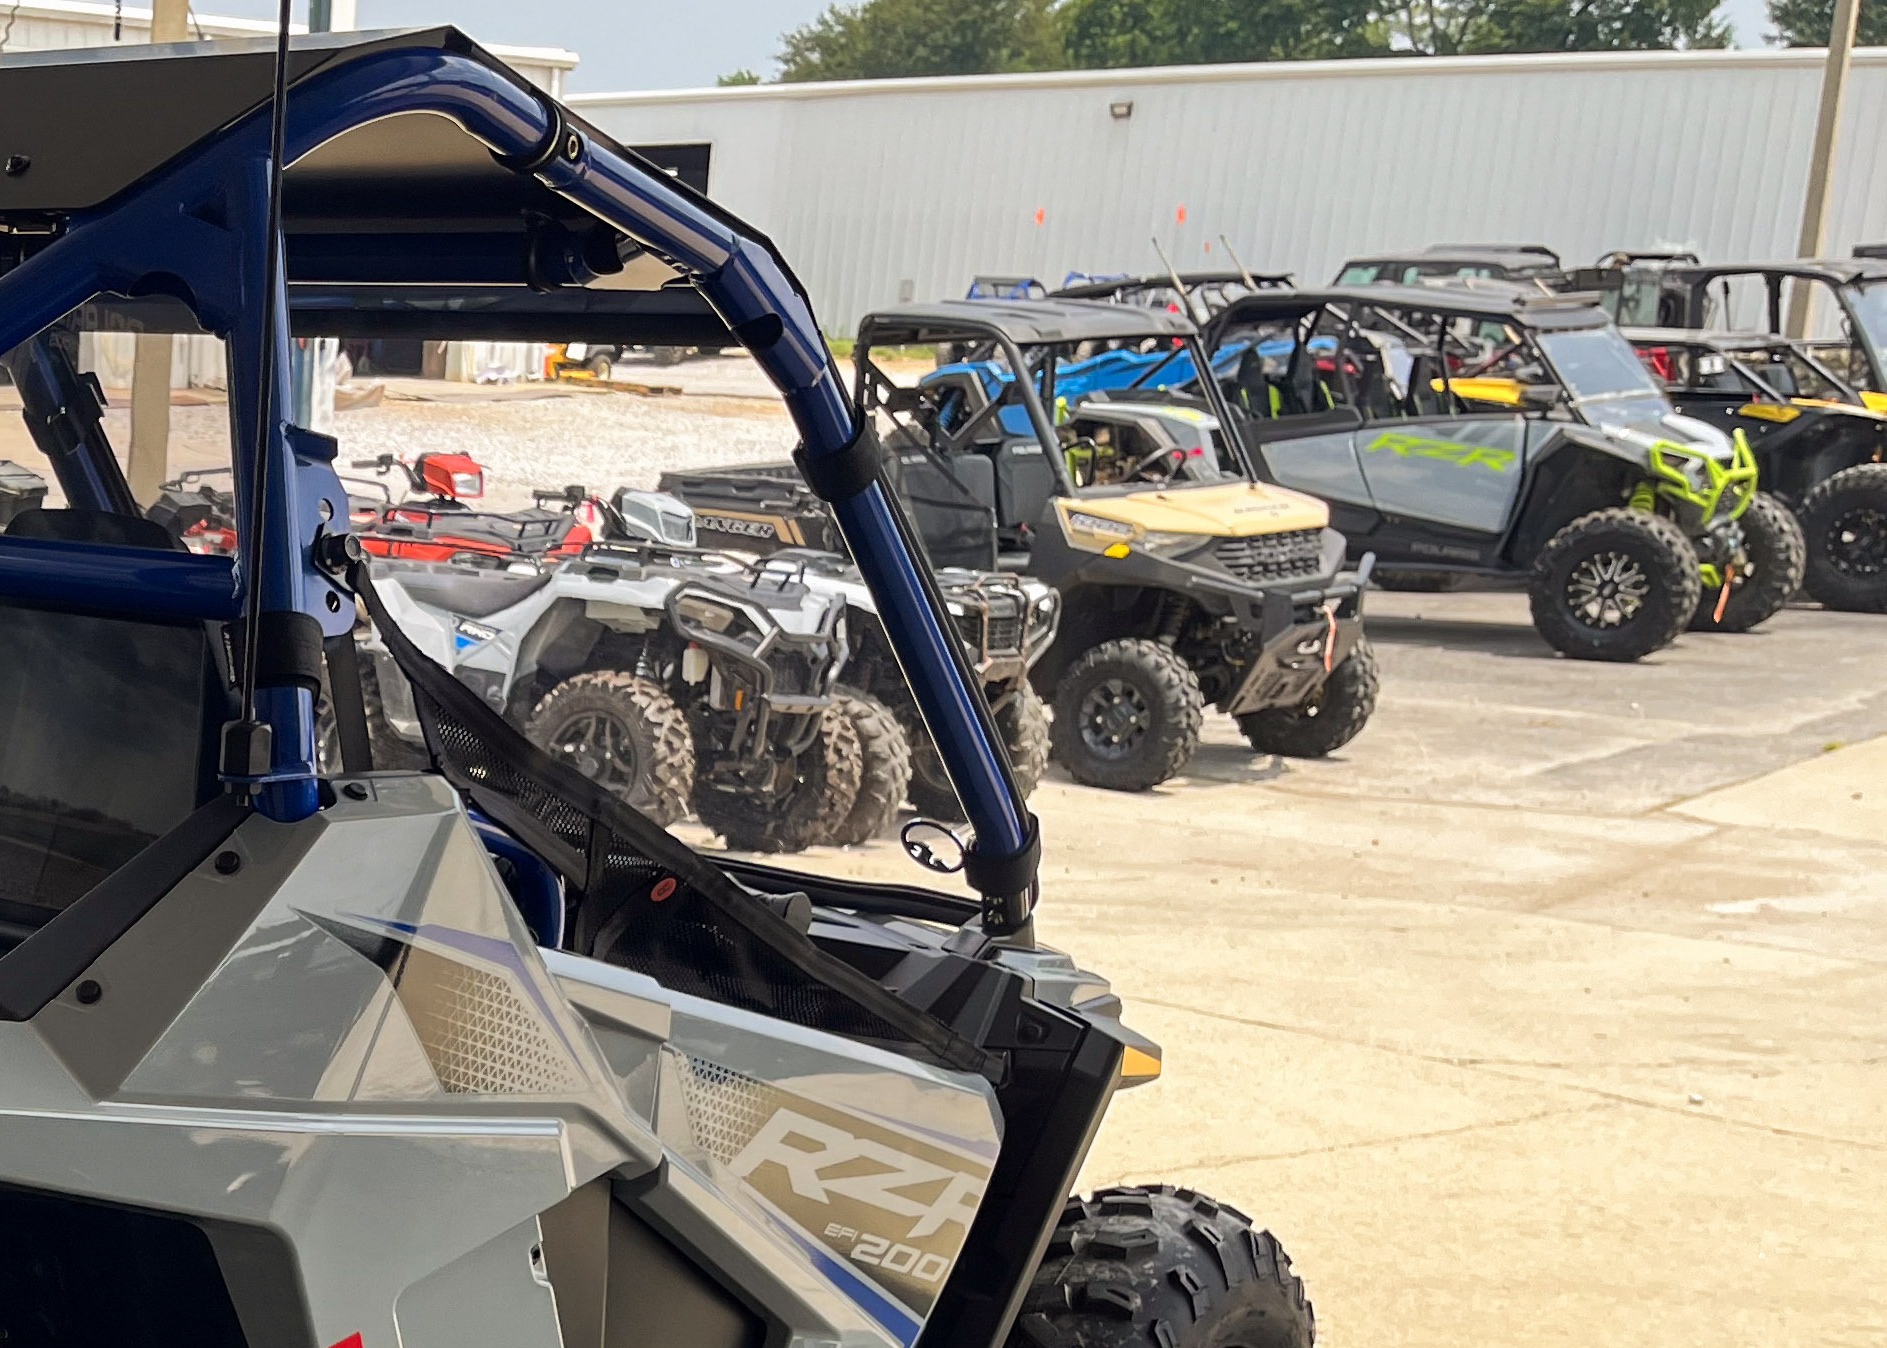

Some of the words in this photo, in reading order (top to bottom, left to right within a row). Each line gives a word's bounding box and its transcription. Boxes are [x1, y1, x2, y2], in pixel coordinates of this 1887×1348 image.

[1367, 432, 1516, 473] RZR
[824, 1222, 858, 1243] EFI
[850, 1233, 950, 1283] 200
